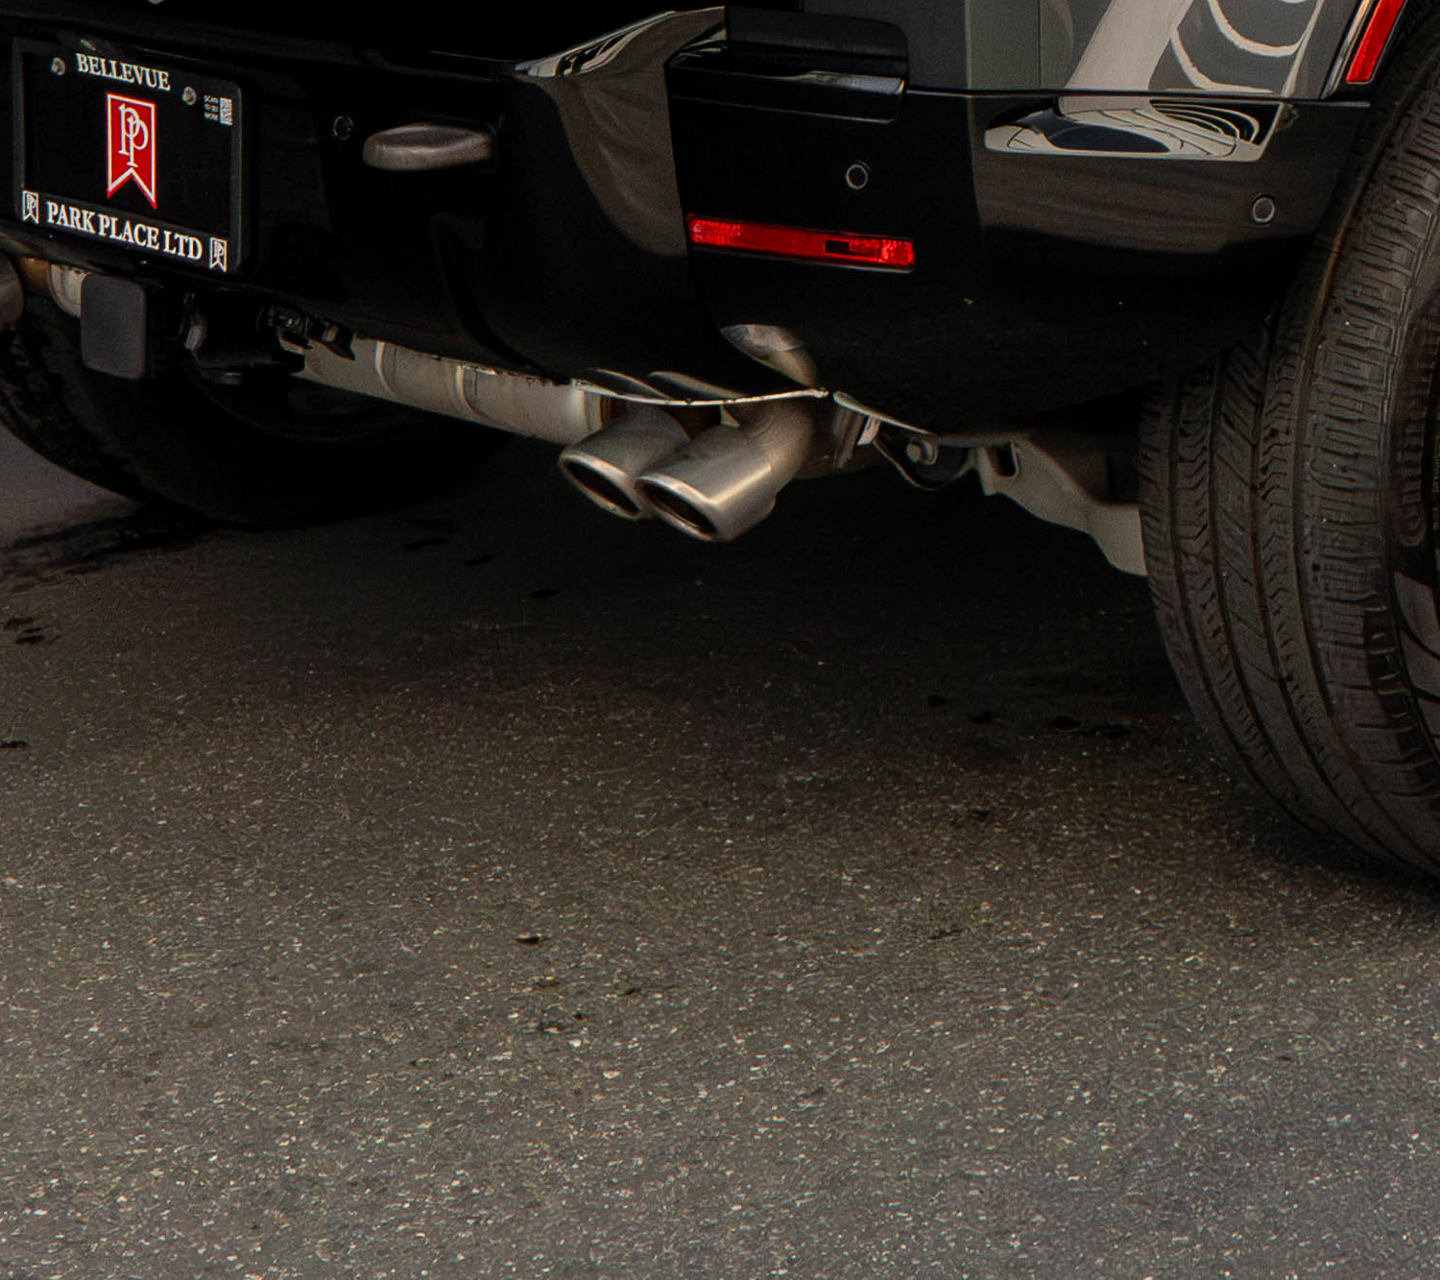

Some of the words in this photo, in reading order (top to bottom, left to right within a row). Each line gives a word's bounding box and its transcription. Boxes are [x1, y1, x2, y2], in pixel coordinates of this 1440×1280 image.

[75, 52, 171, 91] BELLEVUE
[46, 200, 96, 235] PARK
[97, 213, 160, 250] PLACE
[163, 230, 203, 260] LTD
